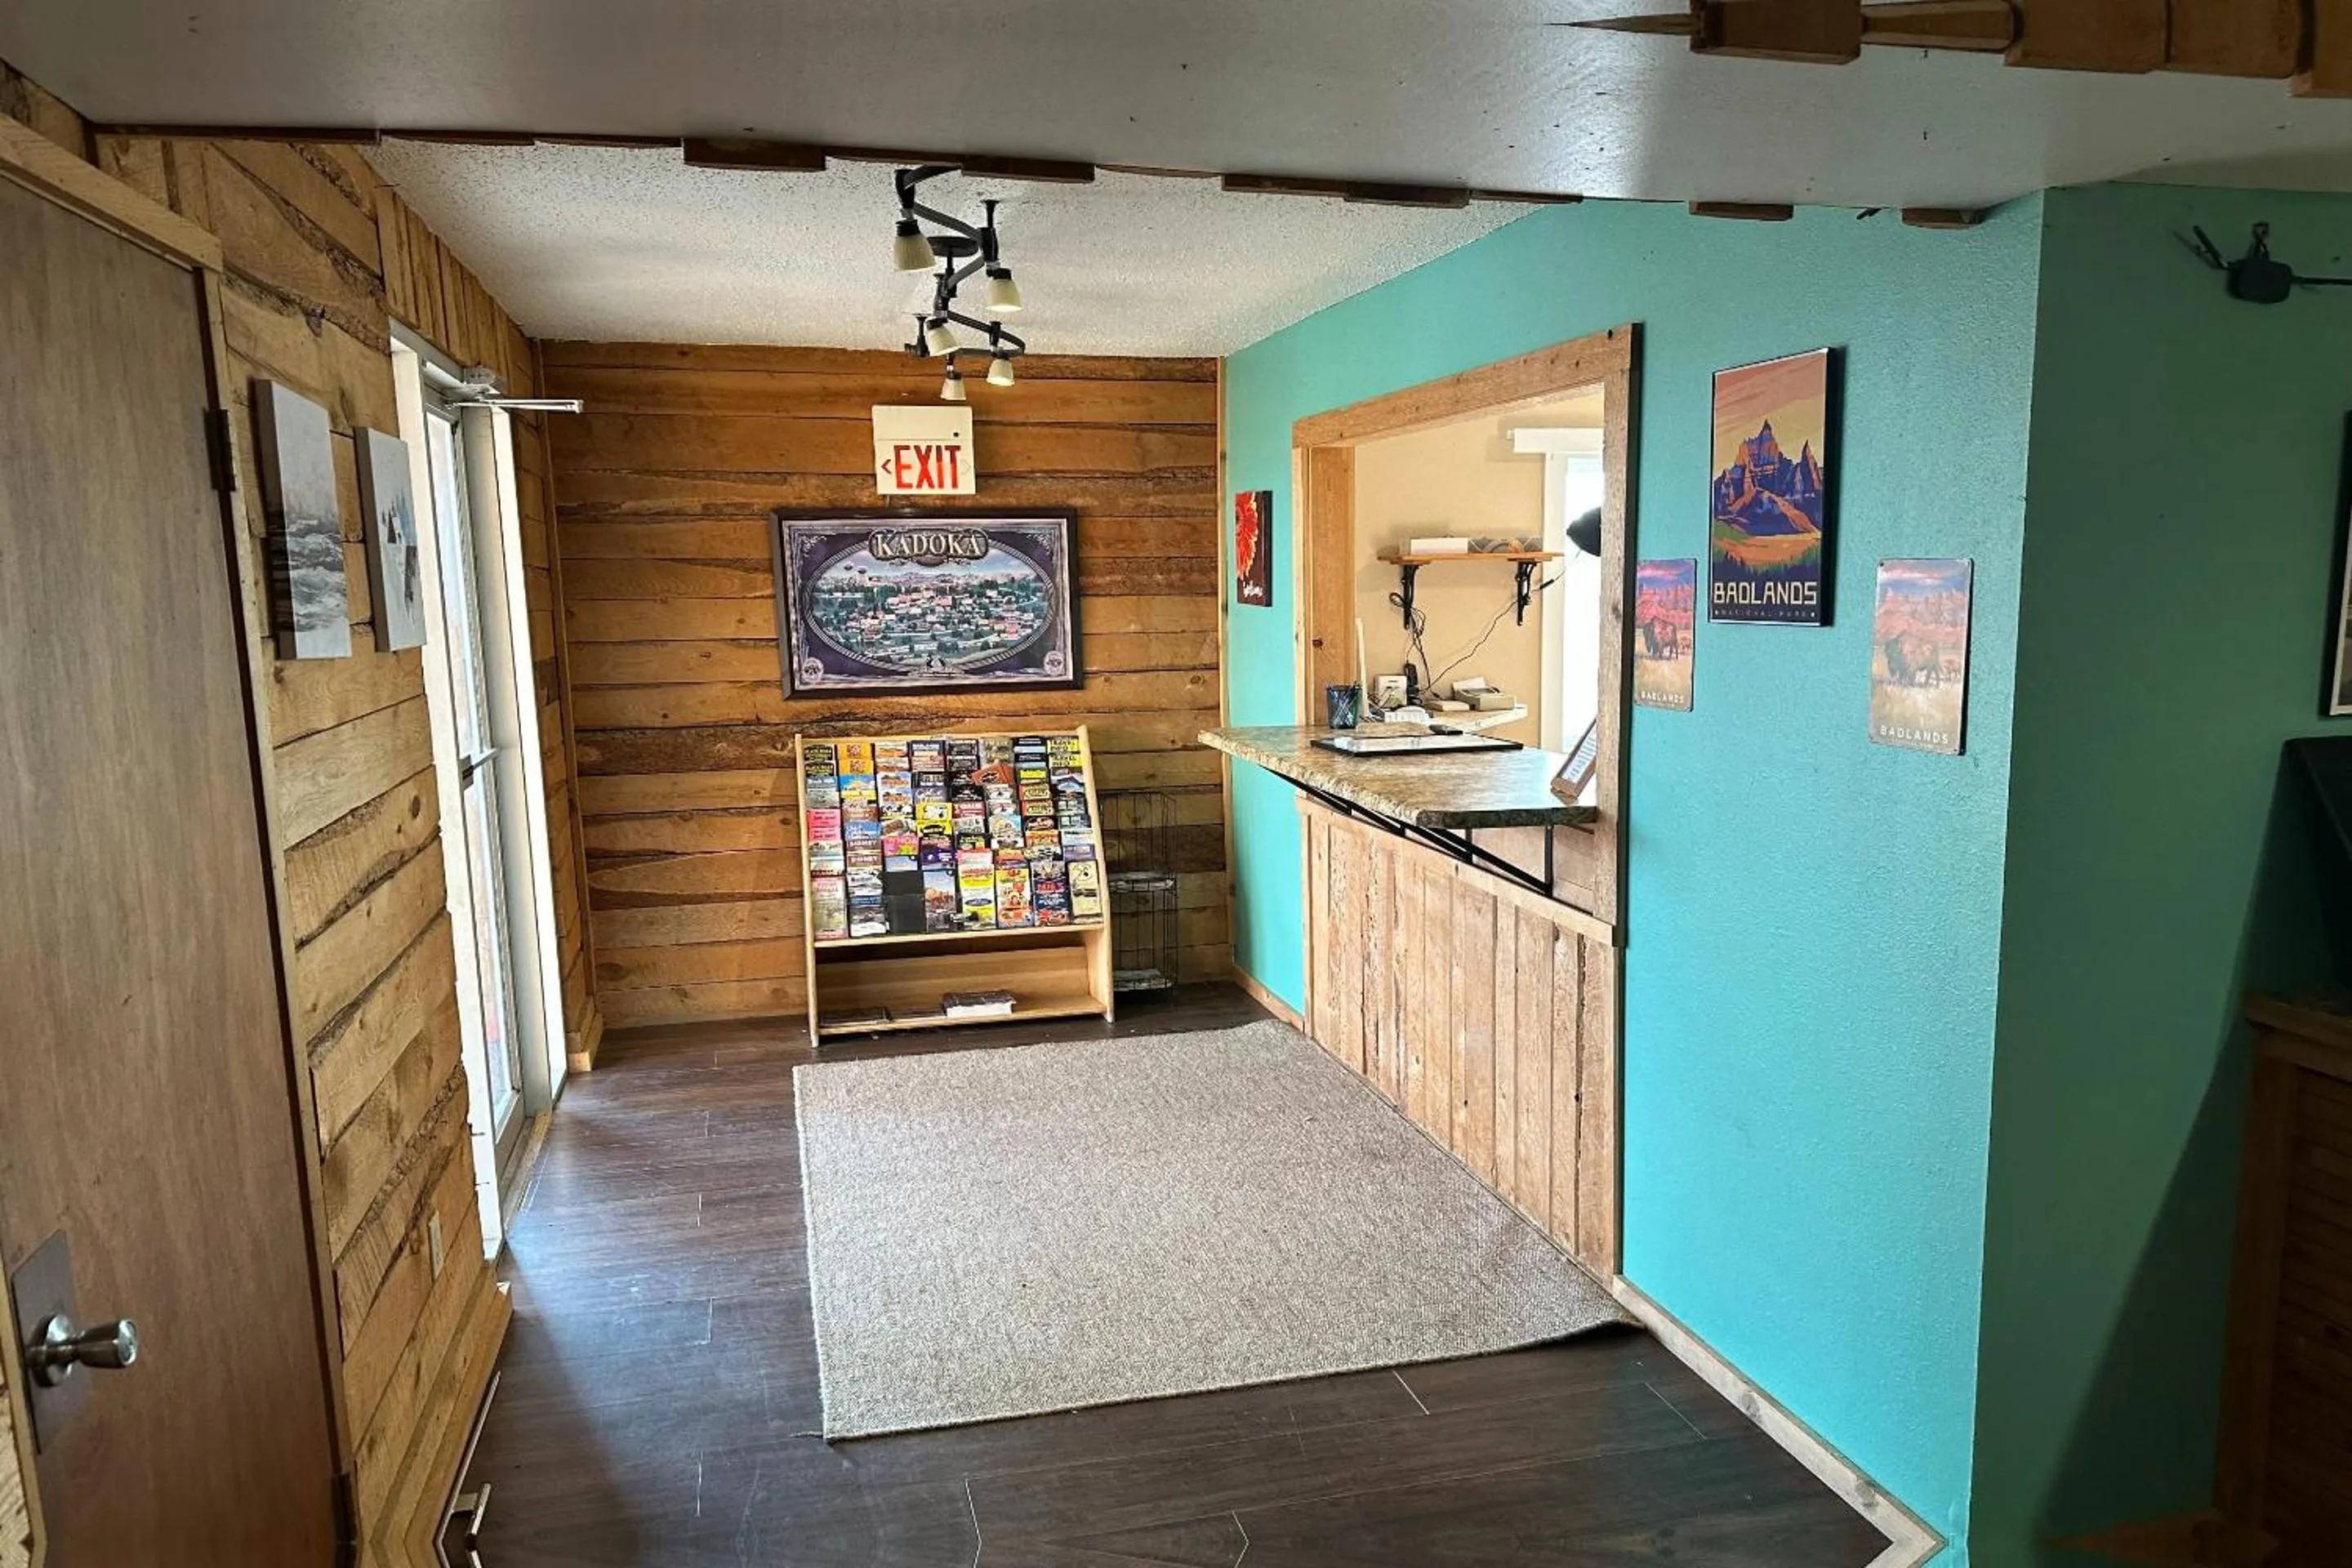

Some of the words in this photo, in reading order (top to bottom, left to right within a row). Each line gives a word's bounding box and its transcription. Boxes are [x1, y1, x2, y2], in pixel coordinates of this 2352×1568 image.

[893, 445, 962, 489] EXIT
[875, 533, 982, 557] KADOKA
[1713, 581, 1817, 605] BADLANDS
[1880, 724, 1949, 744] BADLANDS
